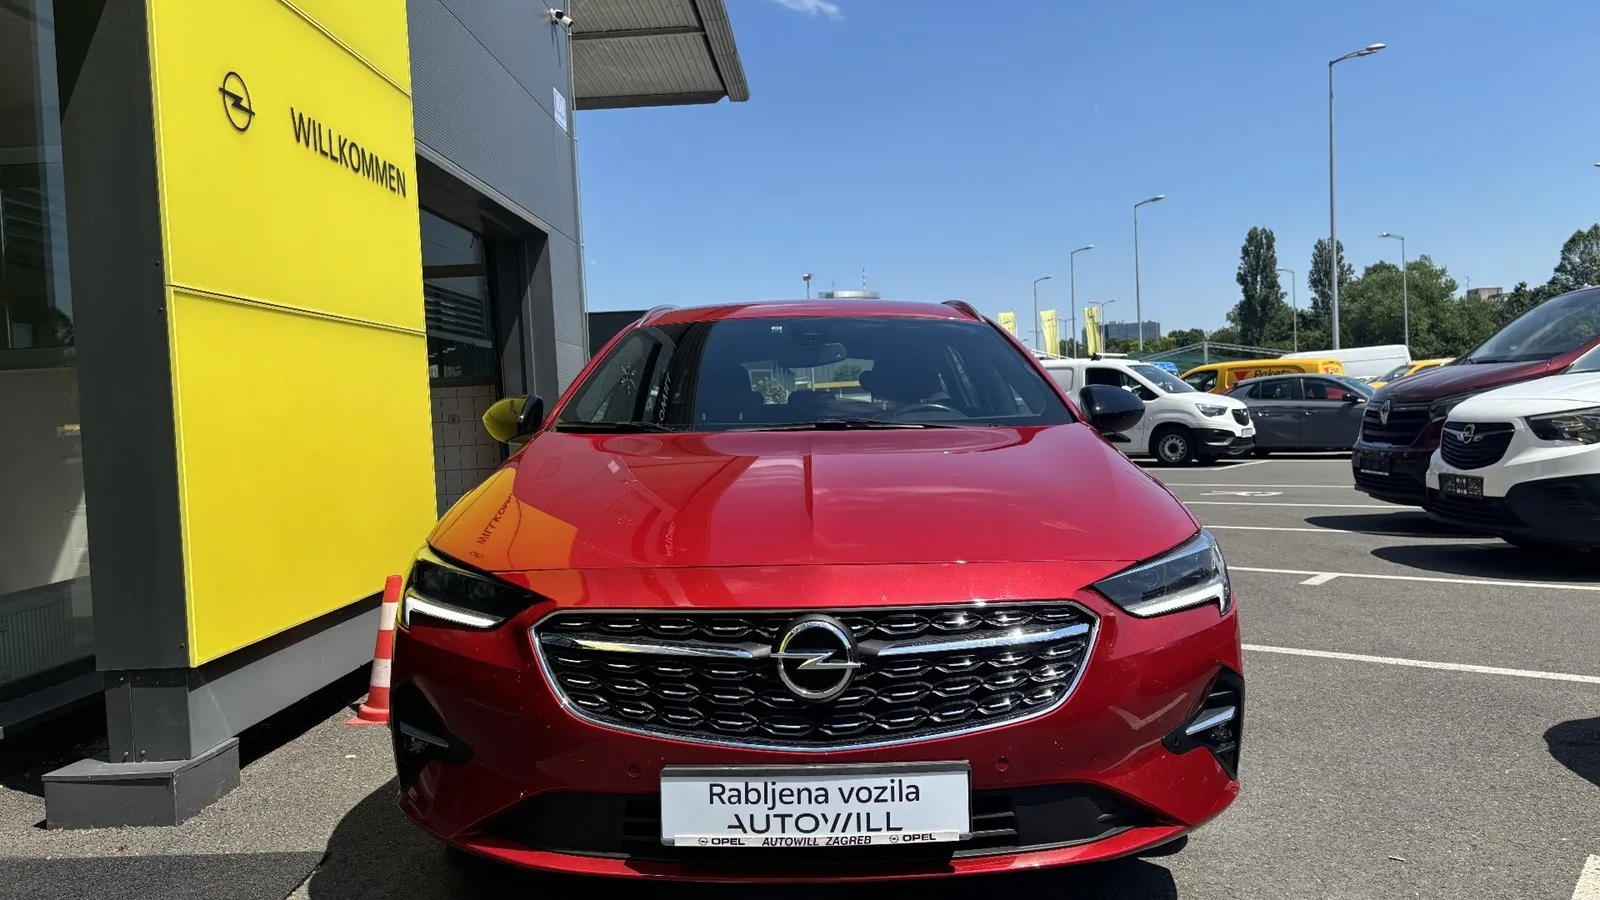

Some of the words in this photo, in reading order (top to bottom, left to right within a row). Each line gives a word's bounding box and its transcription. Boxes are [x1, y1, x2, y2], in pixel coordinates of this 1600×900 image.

[290, 106, 406, 198] WILLKOMMEN
[709, 782, 829, 811] Rabljena
[837, 779, 920, 804] vozila
[727, 812, 903, 834] AUTOWILL
[711, 837, 746, 846] OPEL
[762, 836, 820, 847] AUTOWILL
[826, 835, 872, 846] ZAGREB
[902, 833, 937, 842] OPEL
